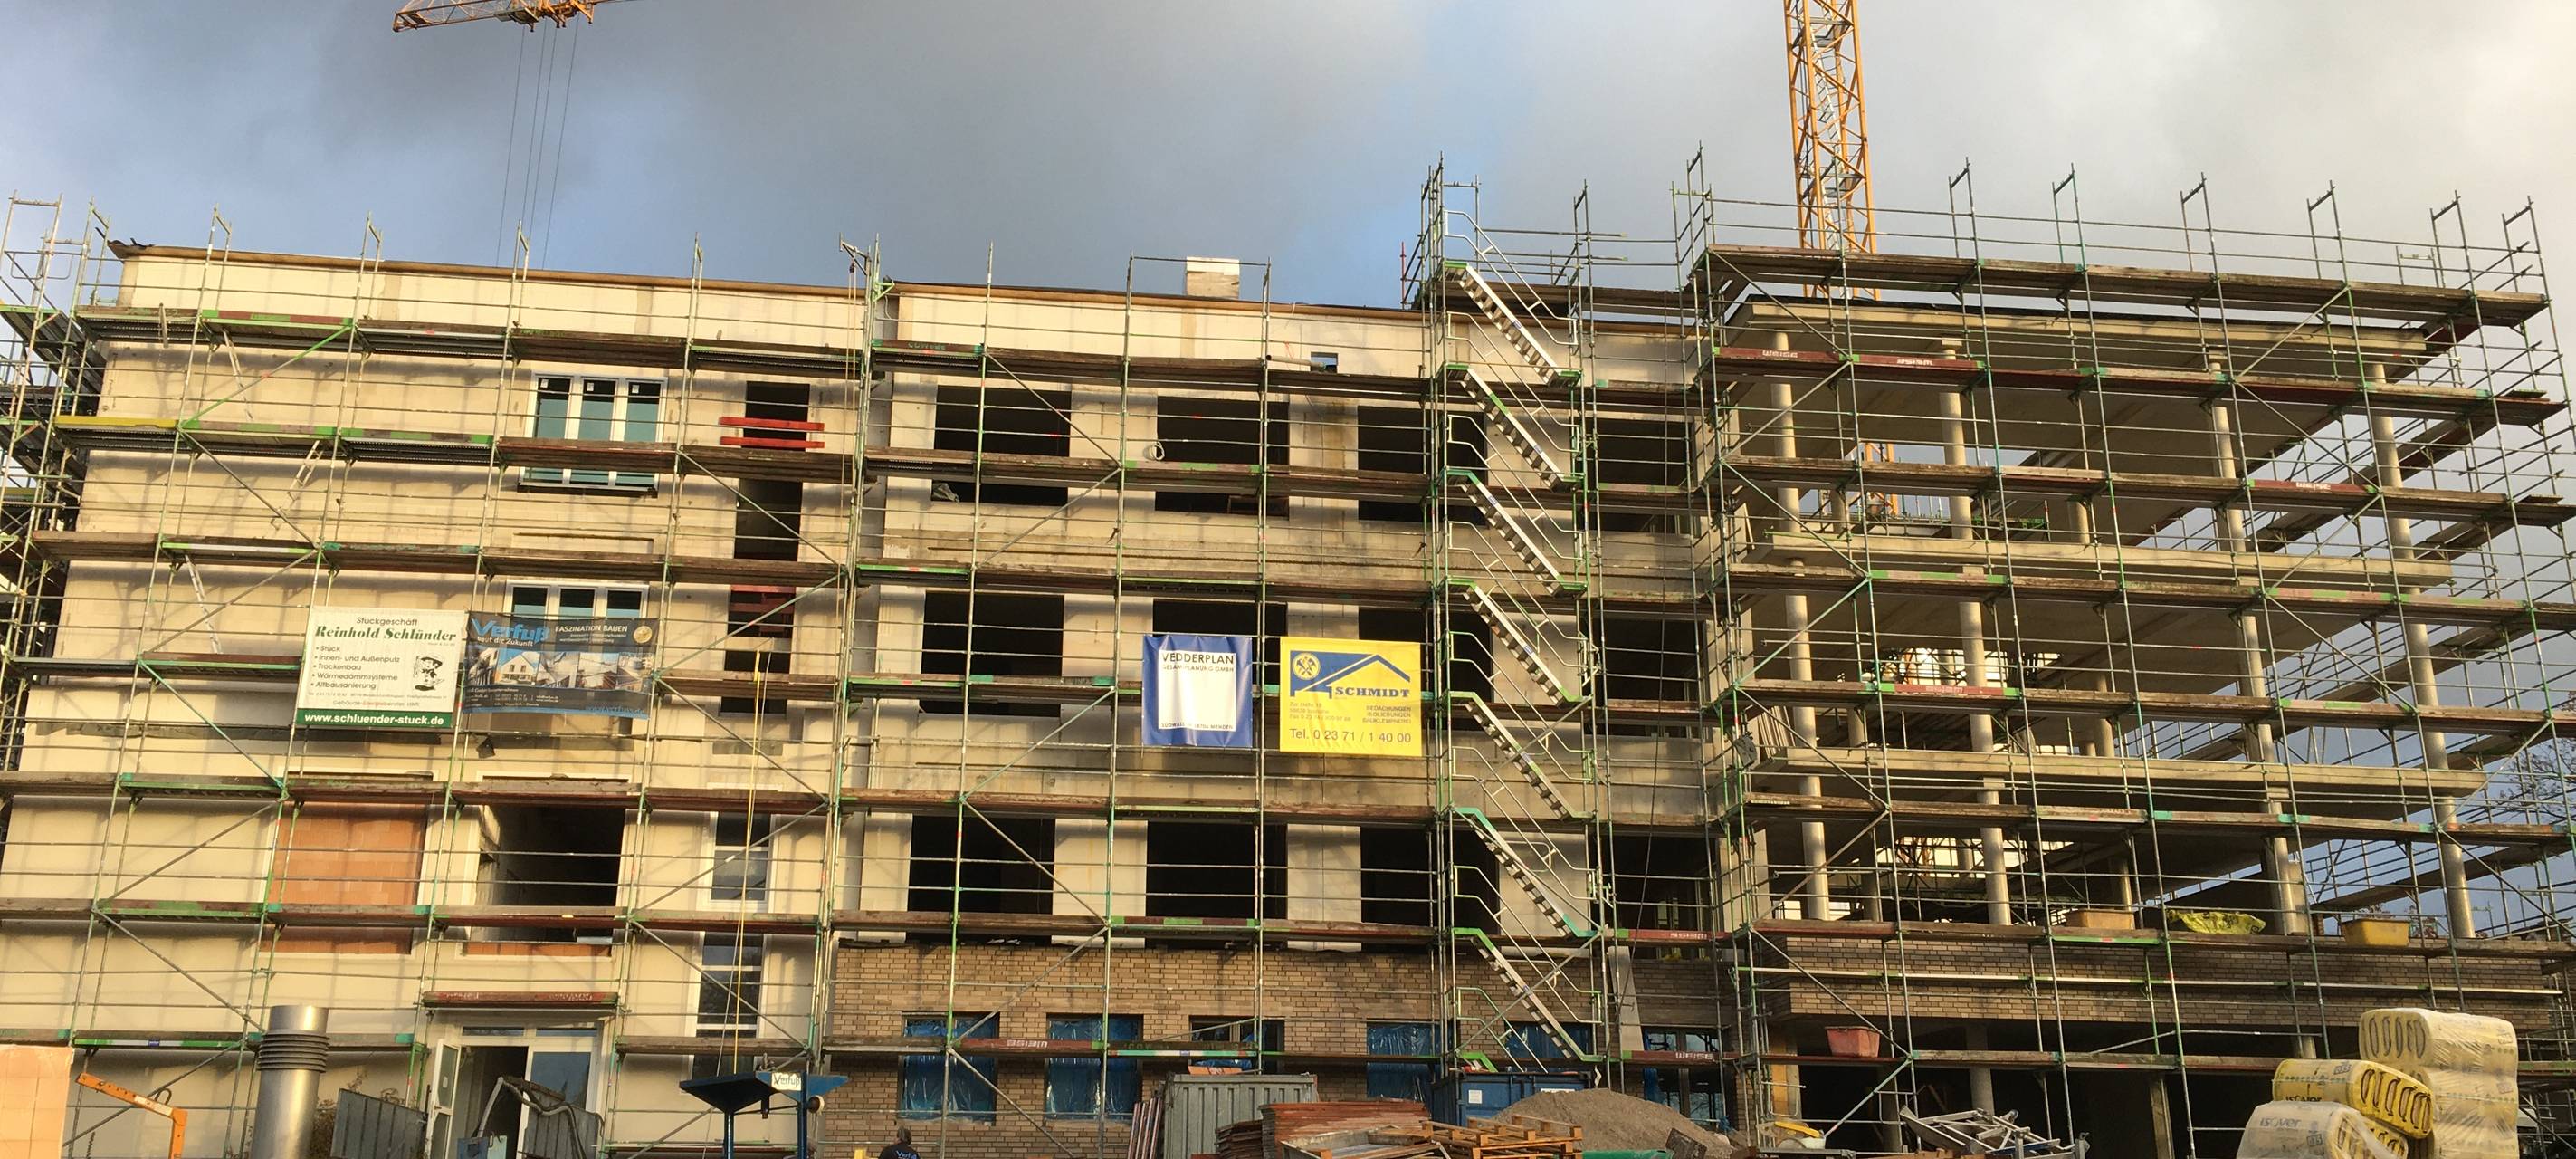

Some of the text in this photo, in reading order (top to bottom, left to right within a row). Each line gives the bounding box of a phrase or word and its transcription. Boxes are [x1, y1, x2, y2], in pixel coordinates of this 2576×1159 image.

[315, 626, 456, 641] Reinhold Schlünder
[471, 618, 550, 645] Verfuß
[506, 638, 533, 647] Zukunft
[361, 656, 401, 664] Außenputz
[1162, 652, 1234, 664] VEDDERPLAN
[318, 663, 362, 671] Trockenbau
[317, 673, 398, 681] Wärmedämmsysteme
[315, 682, 377, 690] Altbausanierung
[1335, 686, 1410, 698] SCHMIDT
[304, 714, 444, 725] www.schluender-stuck.de
[1290, 729, 1310, 739] Tel.
[1313, 730, 1321, 739] 0
[1324, 730, 1339, 740] 23
[1343, 732, 1356, 741] 71
[1379, 733, 1394, 742] 40
[1397, 733, 1411, 743] 00
